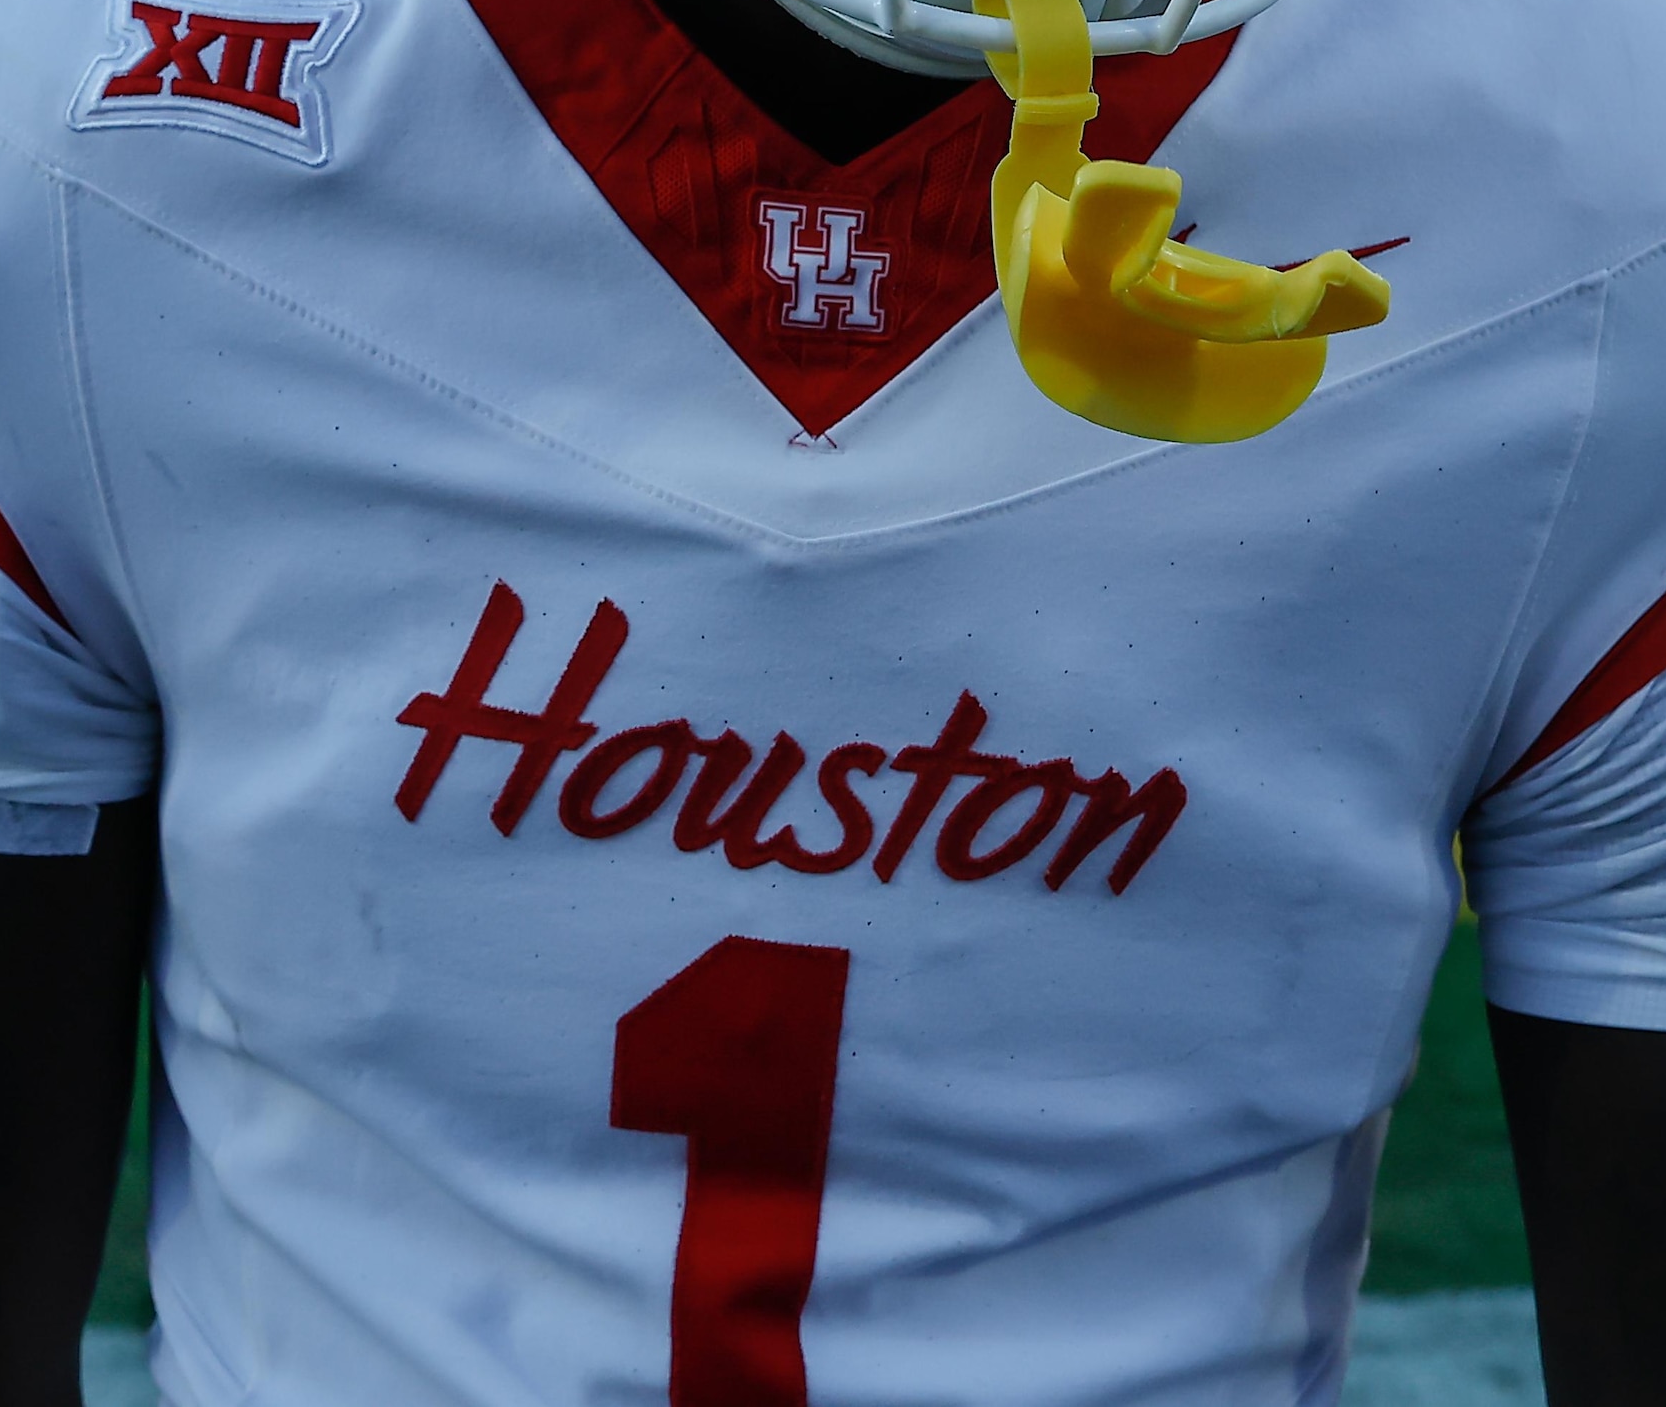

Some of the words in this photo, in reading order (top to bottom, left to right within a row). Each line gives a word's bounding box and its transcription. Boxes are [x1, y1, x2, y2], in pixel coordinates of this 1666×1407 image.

[100, 0, 321, 129] XII
[758, 200, 891, 333] UH
[393, 577, 1189, 897] Houston
[609, 934, 851, 1407] 1
